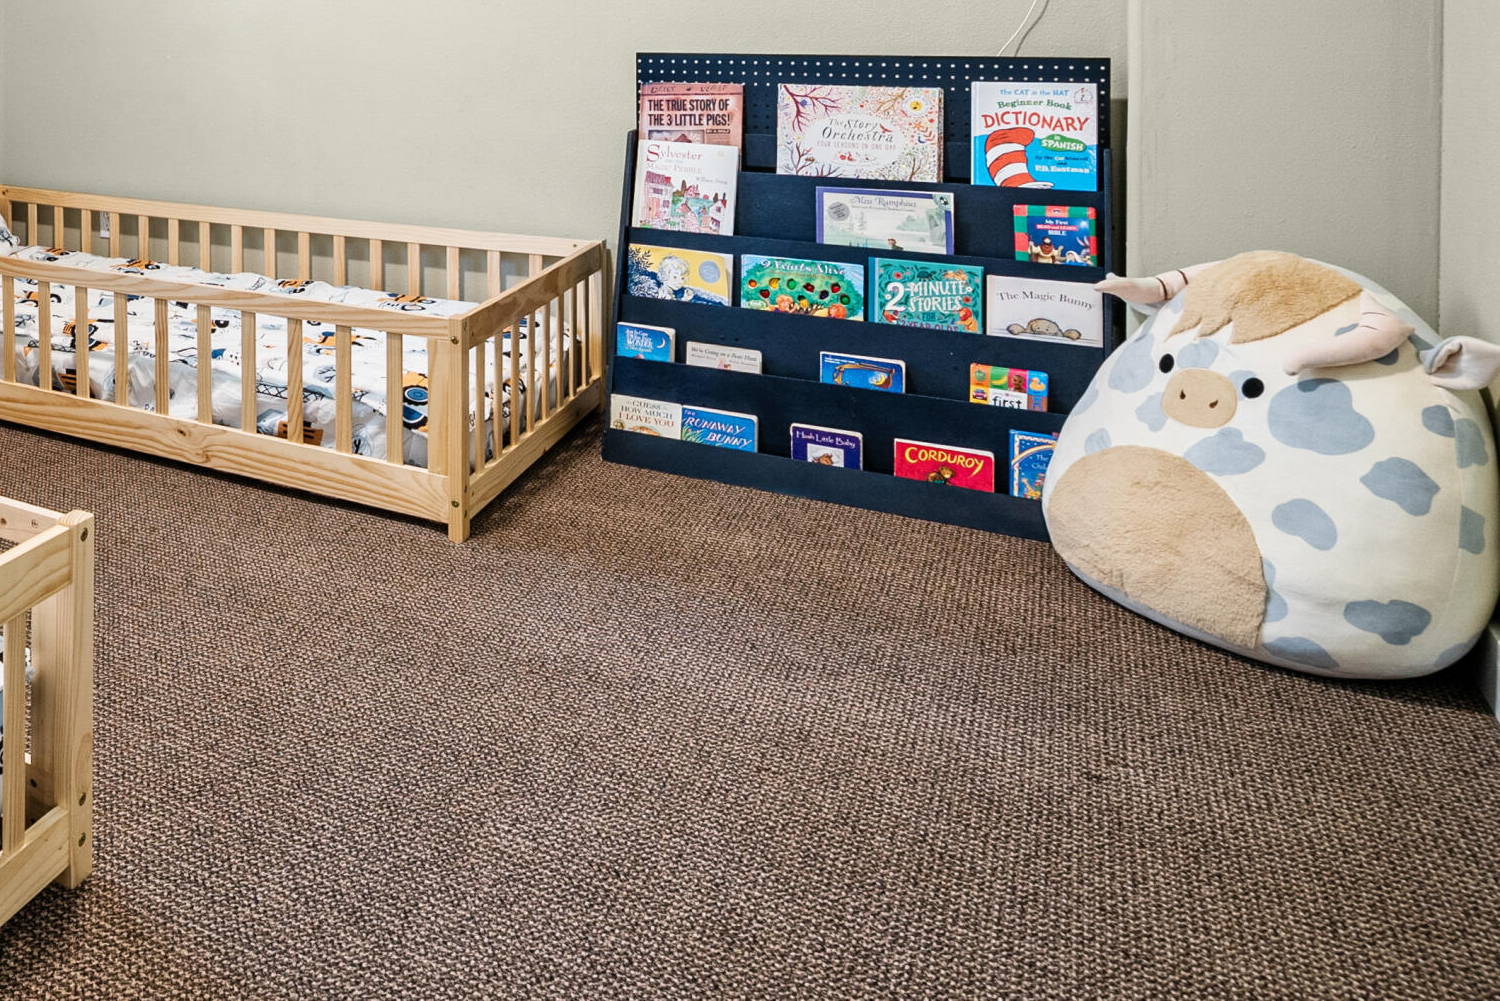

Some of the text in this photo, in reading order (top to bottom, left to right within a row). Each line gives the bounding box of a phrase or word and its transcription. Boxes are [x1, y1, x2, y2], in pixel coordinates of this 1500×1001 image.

[648, 99, 730, 111] THE TRUE STORY OF
[998, 99, 1072, 110] Beginner Book
[648, 113, 730, 126] THE 3 LITTLE PIGS!
[844, 118, 878, 133] Story
[981, 110, 1090, 132] DICTIONARY
[822, 126, 893, 142] Orchestra
[1041, 139, 1083, 151] SPANISH
[646, 144, 703, 162] Sylvester
[908, 296, 964, 314] STORIES
[997, 291, 1093, 310] The Magic Bunny
[992, 395, 1023, 410] first
[621, 405, 673, 420] HOW MUCH
[626, 413, 651, 424] LOVE
[653, 417, 675, 427] YOU
[684, 416, 746, 435] RUNAWAY
[705, 432, 753, 449] BUNNY
[905, 446, 984, 478] CORDUROY
